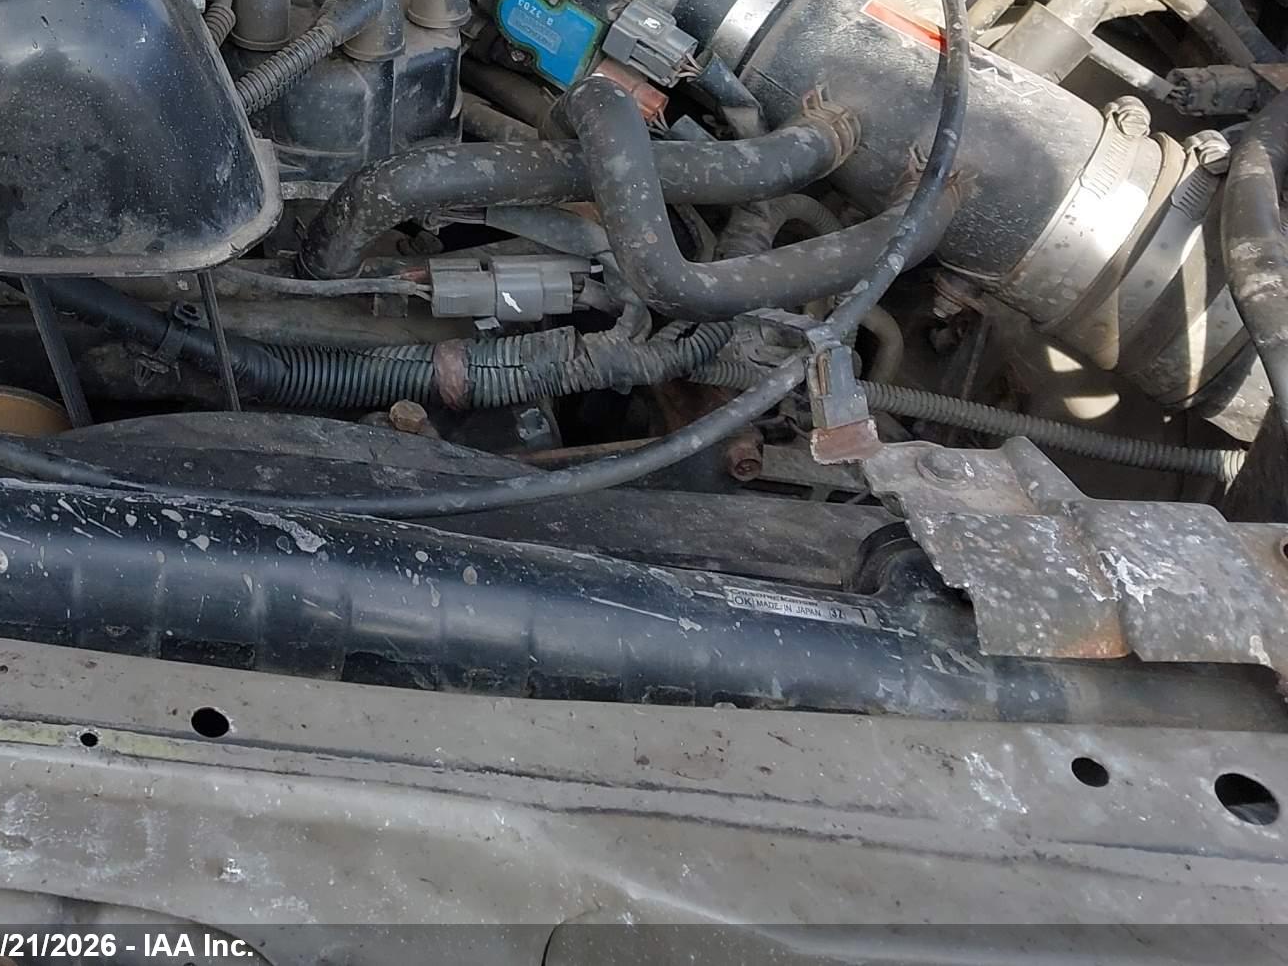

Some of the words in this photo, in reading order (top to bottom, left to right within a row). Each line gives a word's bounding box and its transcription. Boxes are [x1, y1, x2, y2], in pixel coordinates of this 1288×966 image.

[734, 596, 753, 606] OK
[756, 599, 779, 610] MADE
[795, 605, 822, 617] JAPAN
